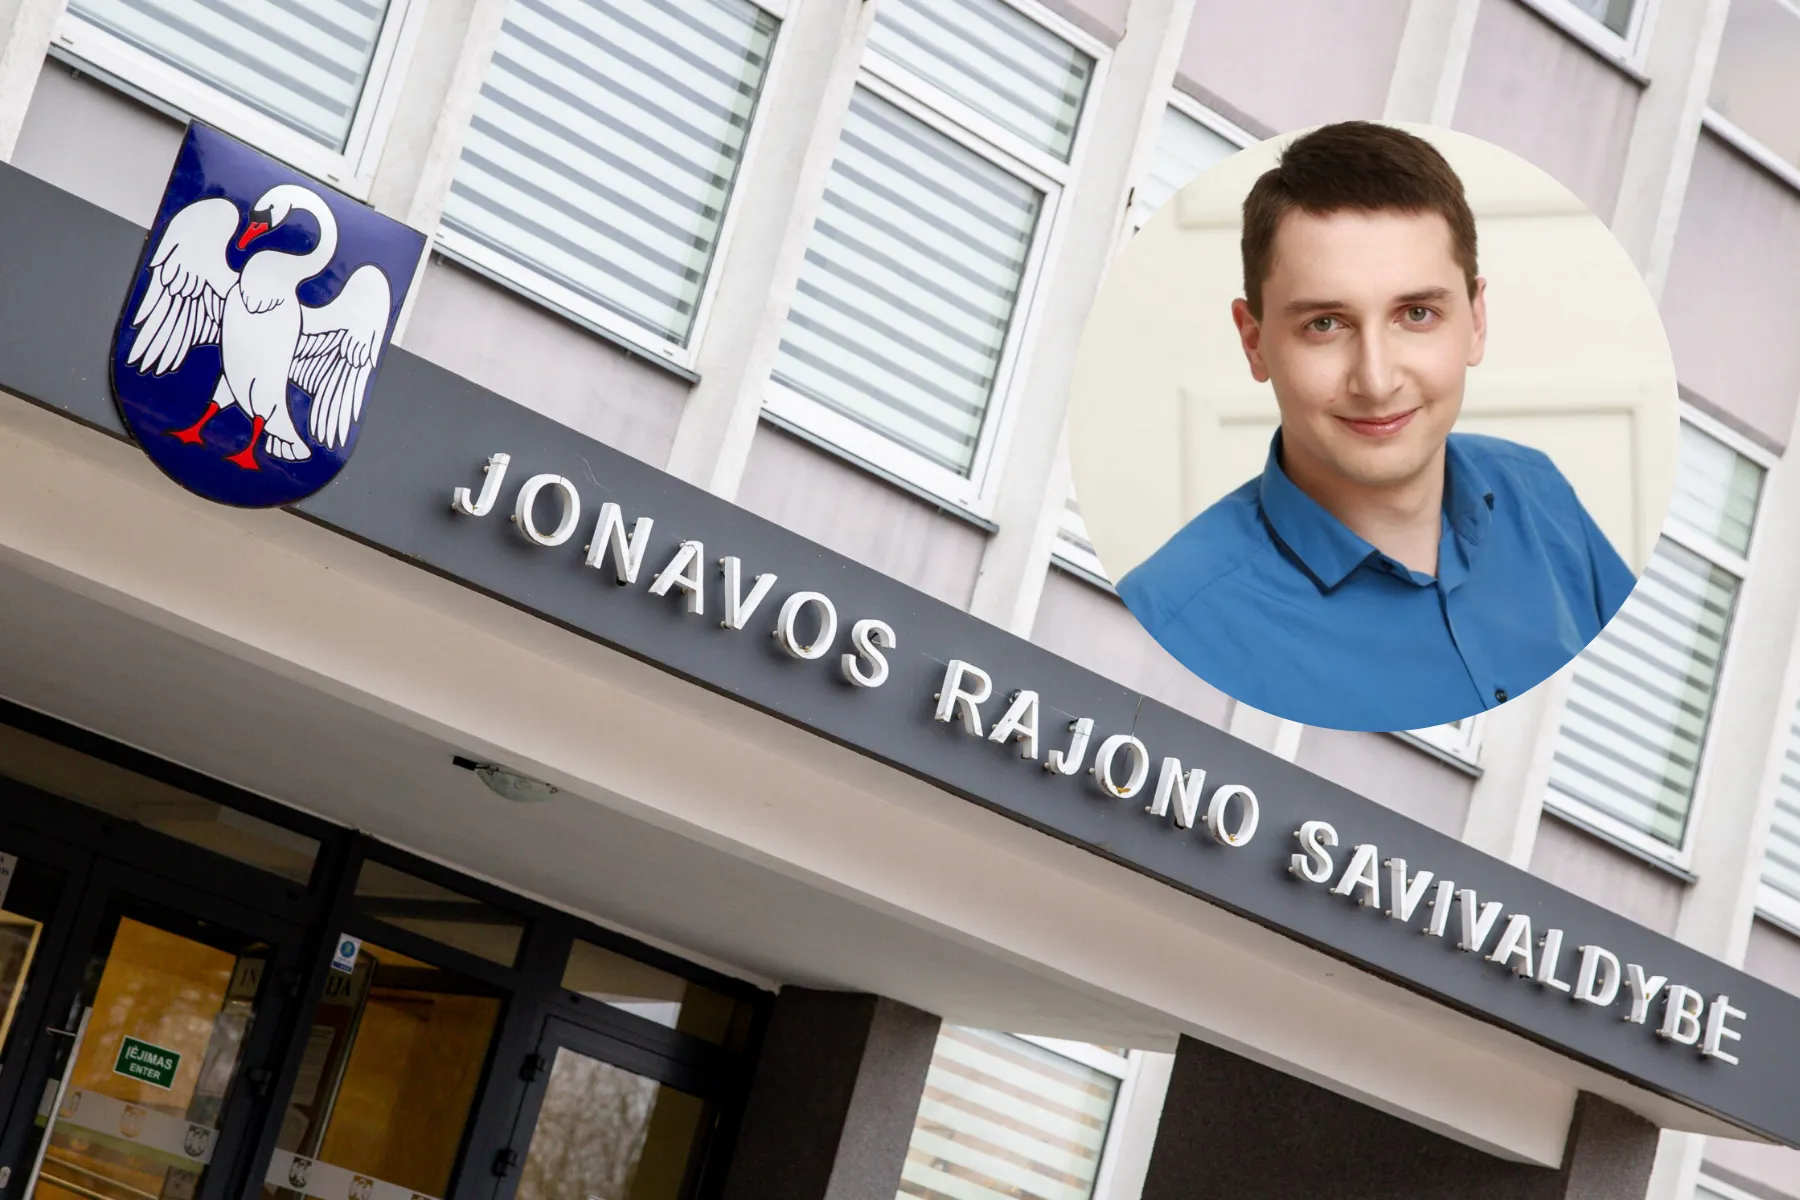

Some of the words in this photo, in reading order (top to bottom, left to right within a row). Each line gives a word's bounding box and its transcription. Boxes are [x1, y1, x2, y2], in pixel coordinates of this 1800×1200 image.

[452, 452, 896, 688] JONAVOS
[934, 659, 1260, 848] RAJONO
[1290, 820, 1747, 1066] SAVIVALDYBĖ
[125, 1044, 173, 1070] ĮĖJIMAS
[129, 1062, 161, 1080] ENTER
